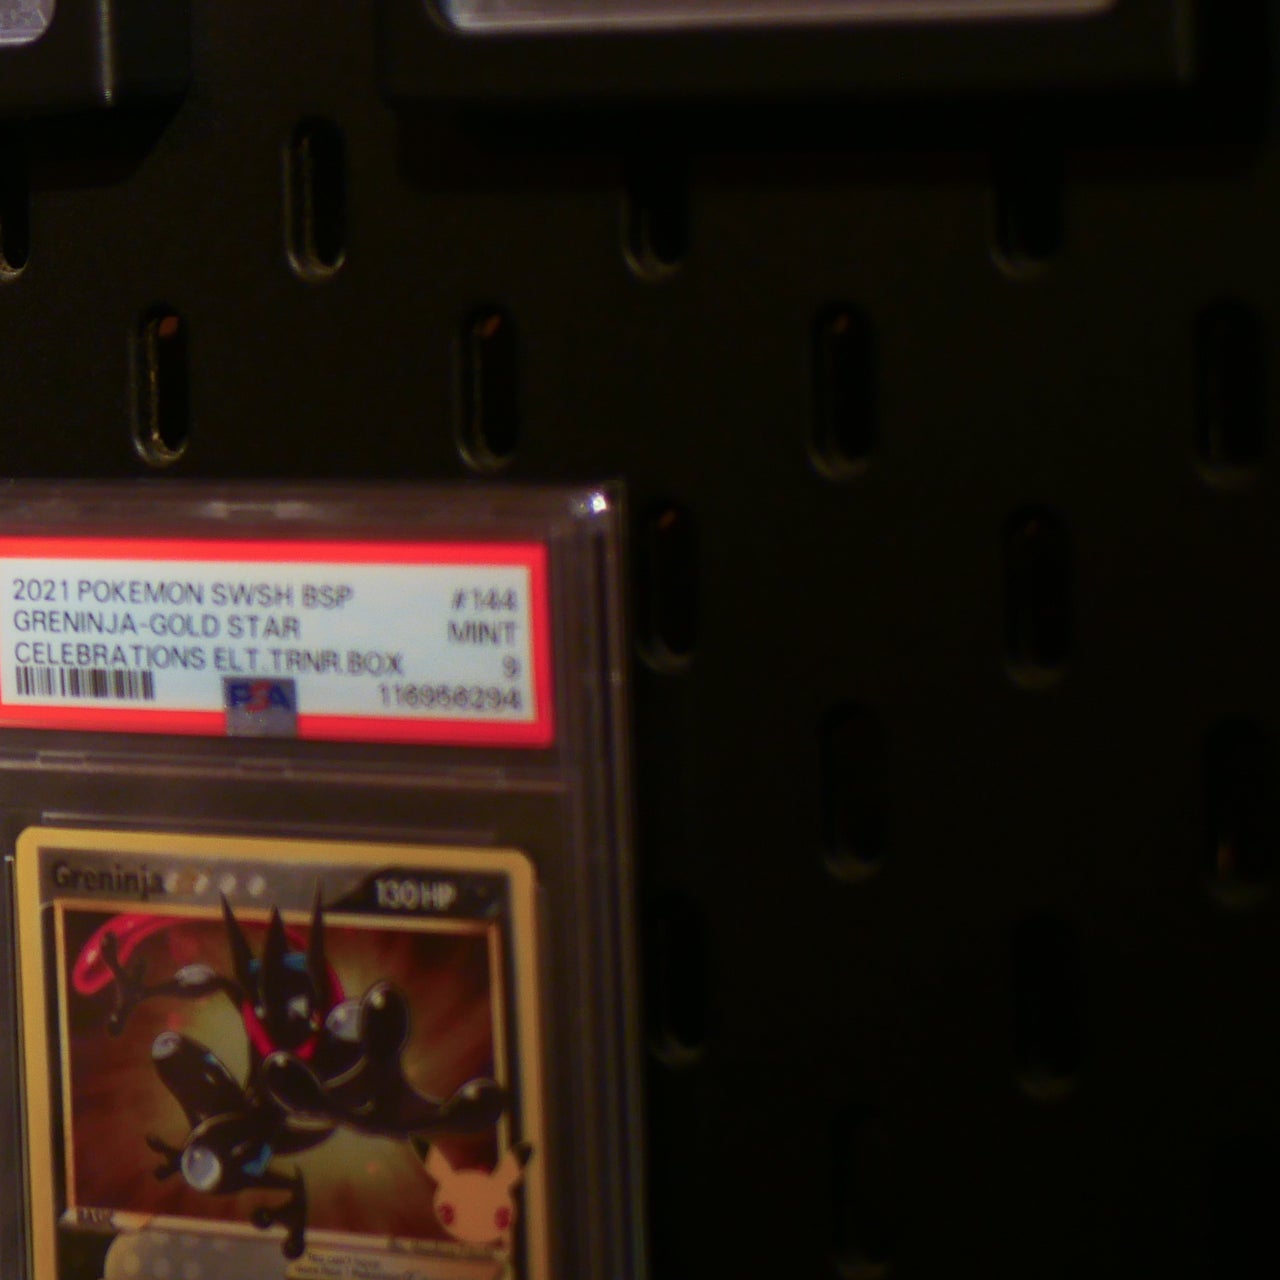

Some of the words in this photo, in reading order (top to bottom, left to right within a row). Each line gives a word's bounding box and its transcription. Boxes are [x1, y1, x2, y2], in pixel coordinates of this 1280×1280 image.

[12, 579, 70, 602] 2021
[78, 580, 203, 606] POKEMON
[211, 584, 293, 607] SWSH
[302, 585, 353, 609] BSP
[451, 587, 517, 611] #144
[14, 611, 220, 638] GRENINJA-GOLD
[228, 616, 301, 639] STAR
[448, 620, 517, 644] MINT
[15, 642, 207, 670] CELEBRATIONS
[502, 655, 521, 679] 9
[52, 862, 165, 898] Greninja
